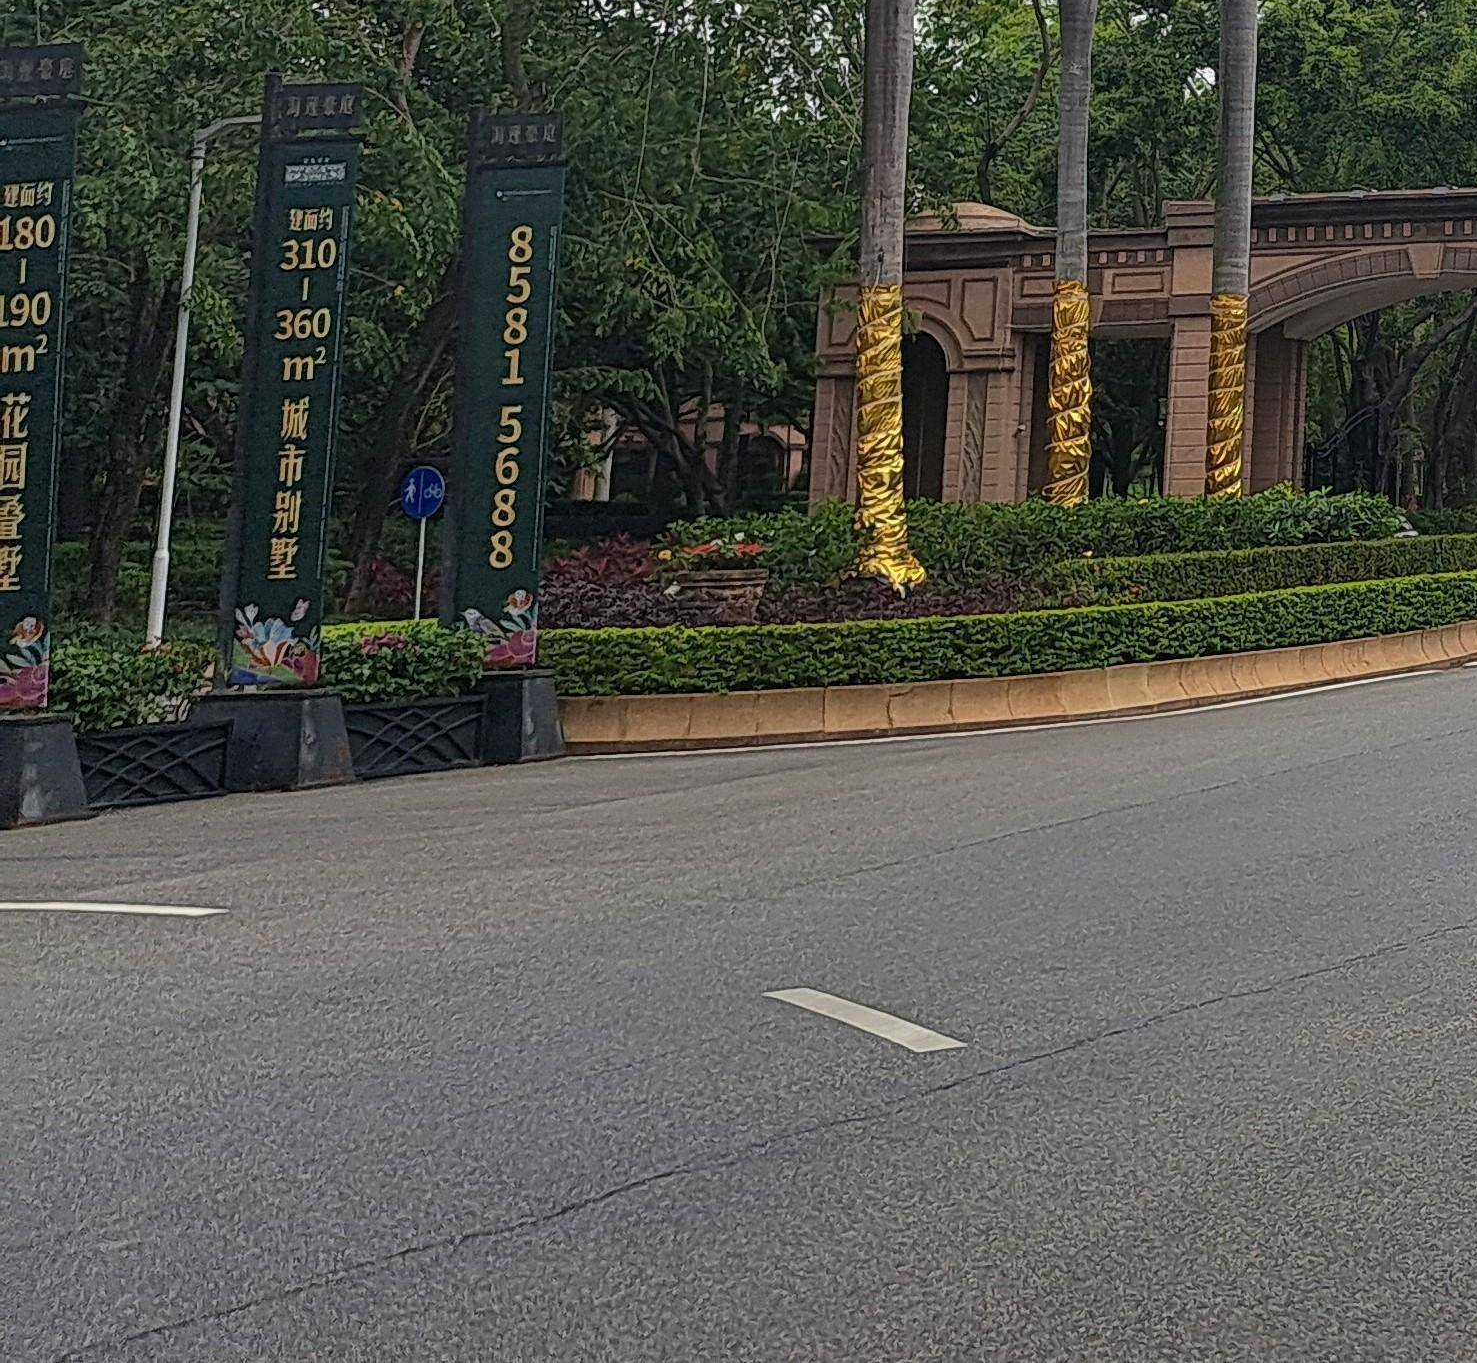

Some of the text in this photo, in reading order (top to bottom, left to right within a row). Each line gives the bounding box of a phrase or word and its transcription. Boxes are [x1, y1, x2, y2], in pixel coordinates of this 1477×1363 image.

[279, 237, 336, 271] 310
[273, 307, 331, 340] 360
[267, 396, 310, 580] 城市别墅
